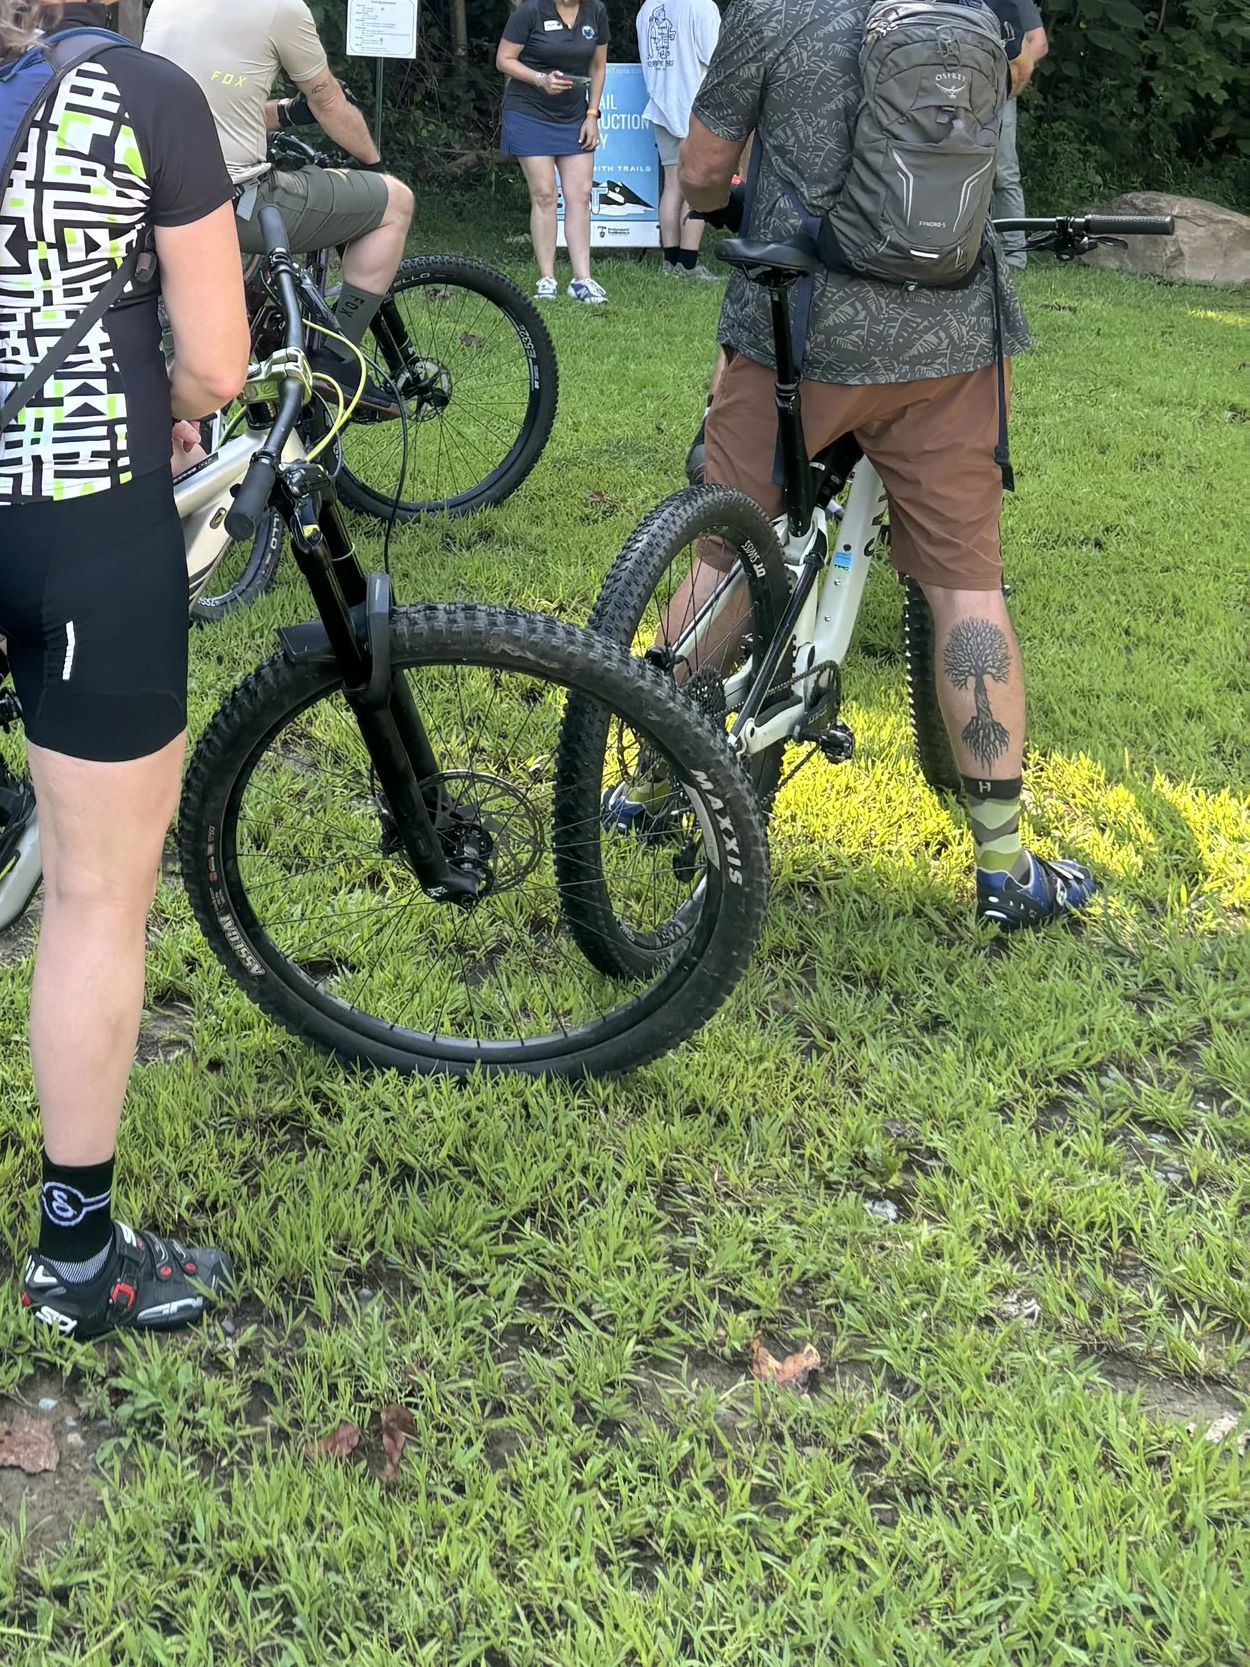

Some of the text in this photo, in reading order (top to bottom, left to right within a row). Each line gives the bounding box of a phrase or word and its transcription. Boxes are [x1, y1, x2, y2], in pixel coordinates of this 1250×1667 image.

[210, 70, 247, 87] FOX
[935, 72, 966, 82] OSPREY
[600, 94, 617, 110] AIL
[597, 114, 649, 130] UCTION
[393, 272, 431, 288] ELLO
[339, 295, 365, 318] FOX
[741, 540, 766, 578] DT SWISS
[690, 768, 742, 886] MAXXIS
[219, 912, 266, 976] ASSEGAI
